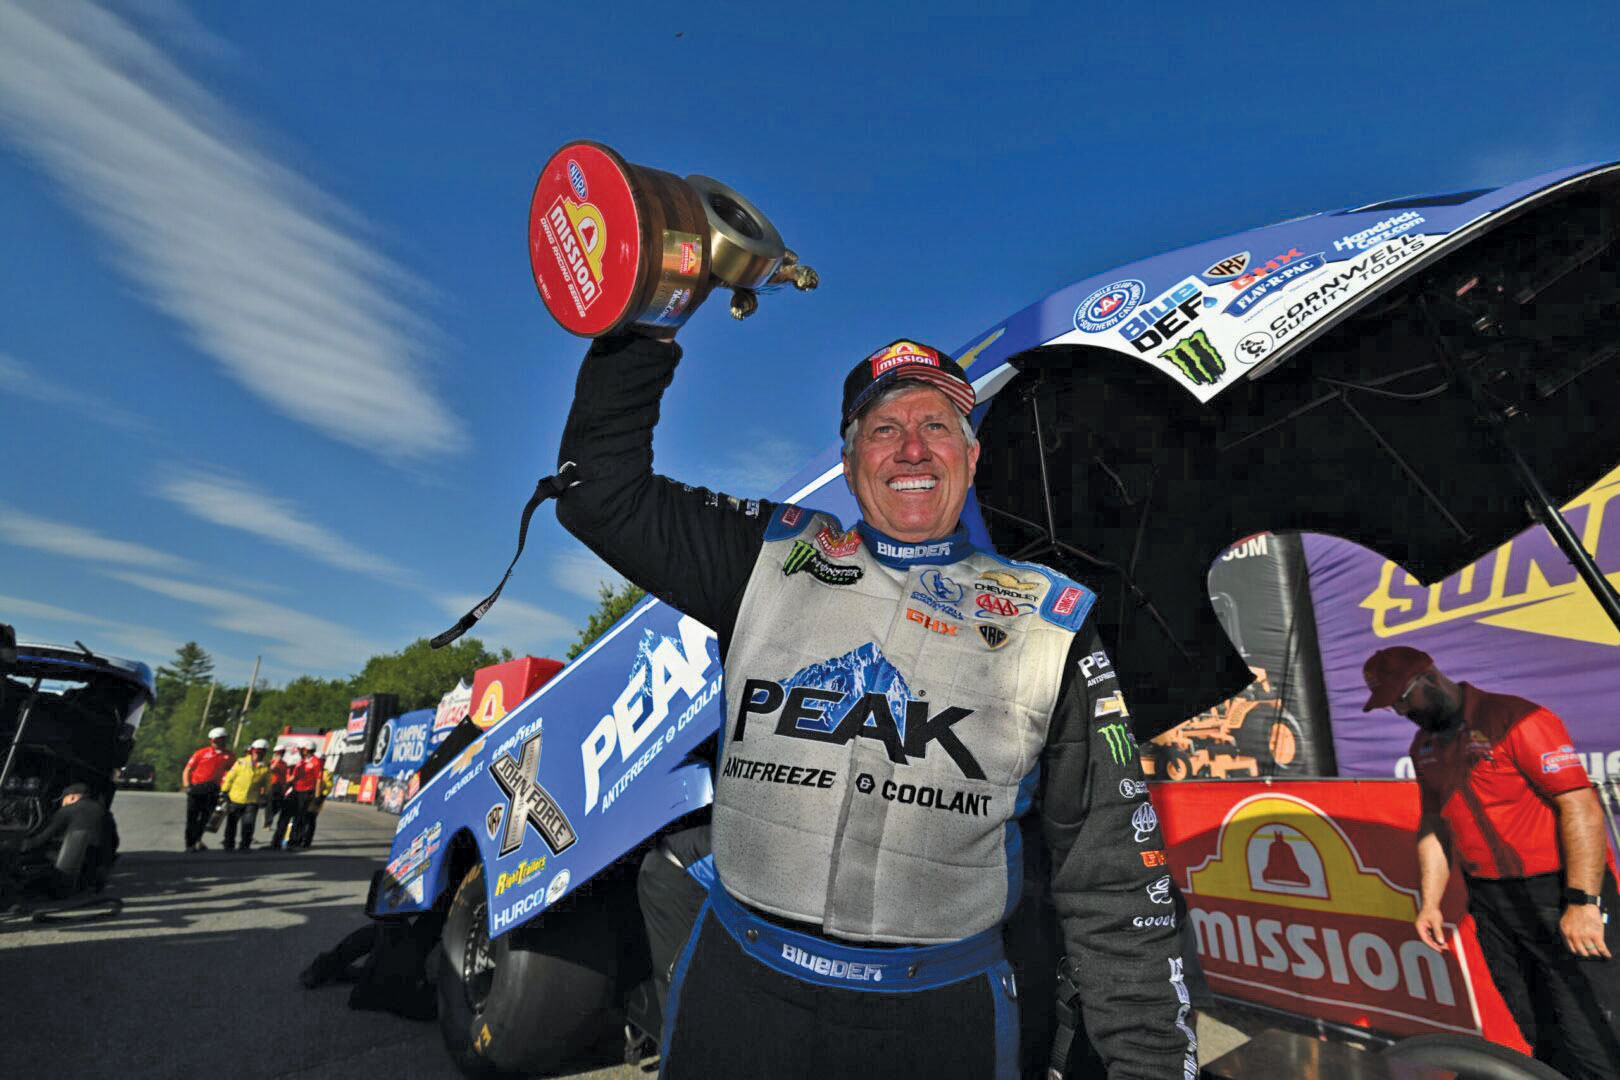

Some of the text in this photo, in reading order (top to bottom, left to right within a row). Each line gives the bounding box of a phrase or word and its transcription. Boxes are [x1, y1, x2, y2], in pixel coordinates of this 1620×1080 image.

[569, 164, 587, 198] NHRA
[1333, 211, 1420, 252] Hendrick
[1356, 217, 1426, 250] Cars.com
[552, 245, 571, 282] RACING
[1270, 234, 1416, 332] CORNWELL
[1079, 283, 1141, 332] SOUTHERN CALIFORNIA
[1093, 293, 1124, 317] AAA
[1275, 283, 1350, 339] QUALITY
[1358, 240, 1426, 282] TOOLS
[1118, 283, 1199, 341] Blue
[1130, 290, 1203, 353] DEF
[974, 582, 1039, 603] CHEVROLET
[976, 594, 1019, 616] AAA
[906, 607, 959, 637] GHX
[491, 717, 543, 761] GOODYEAR
[732, 678, 988, 781] PEAK
[443, 760, 485, 802] CHEVROLET
[602, 733, 665, 814] ANTIFREEZE
[722, 757, 837, 789] ANTIFREEZE
[881, 779, 993, 817] COOLANT
[499, 760, 531, 797] JOHN
[526, 789, 568, 843] FORCE
[493, 887, 545, 931] HURCO
